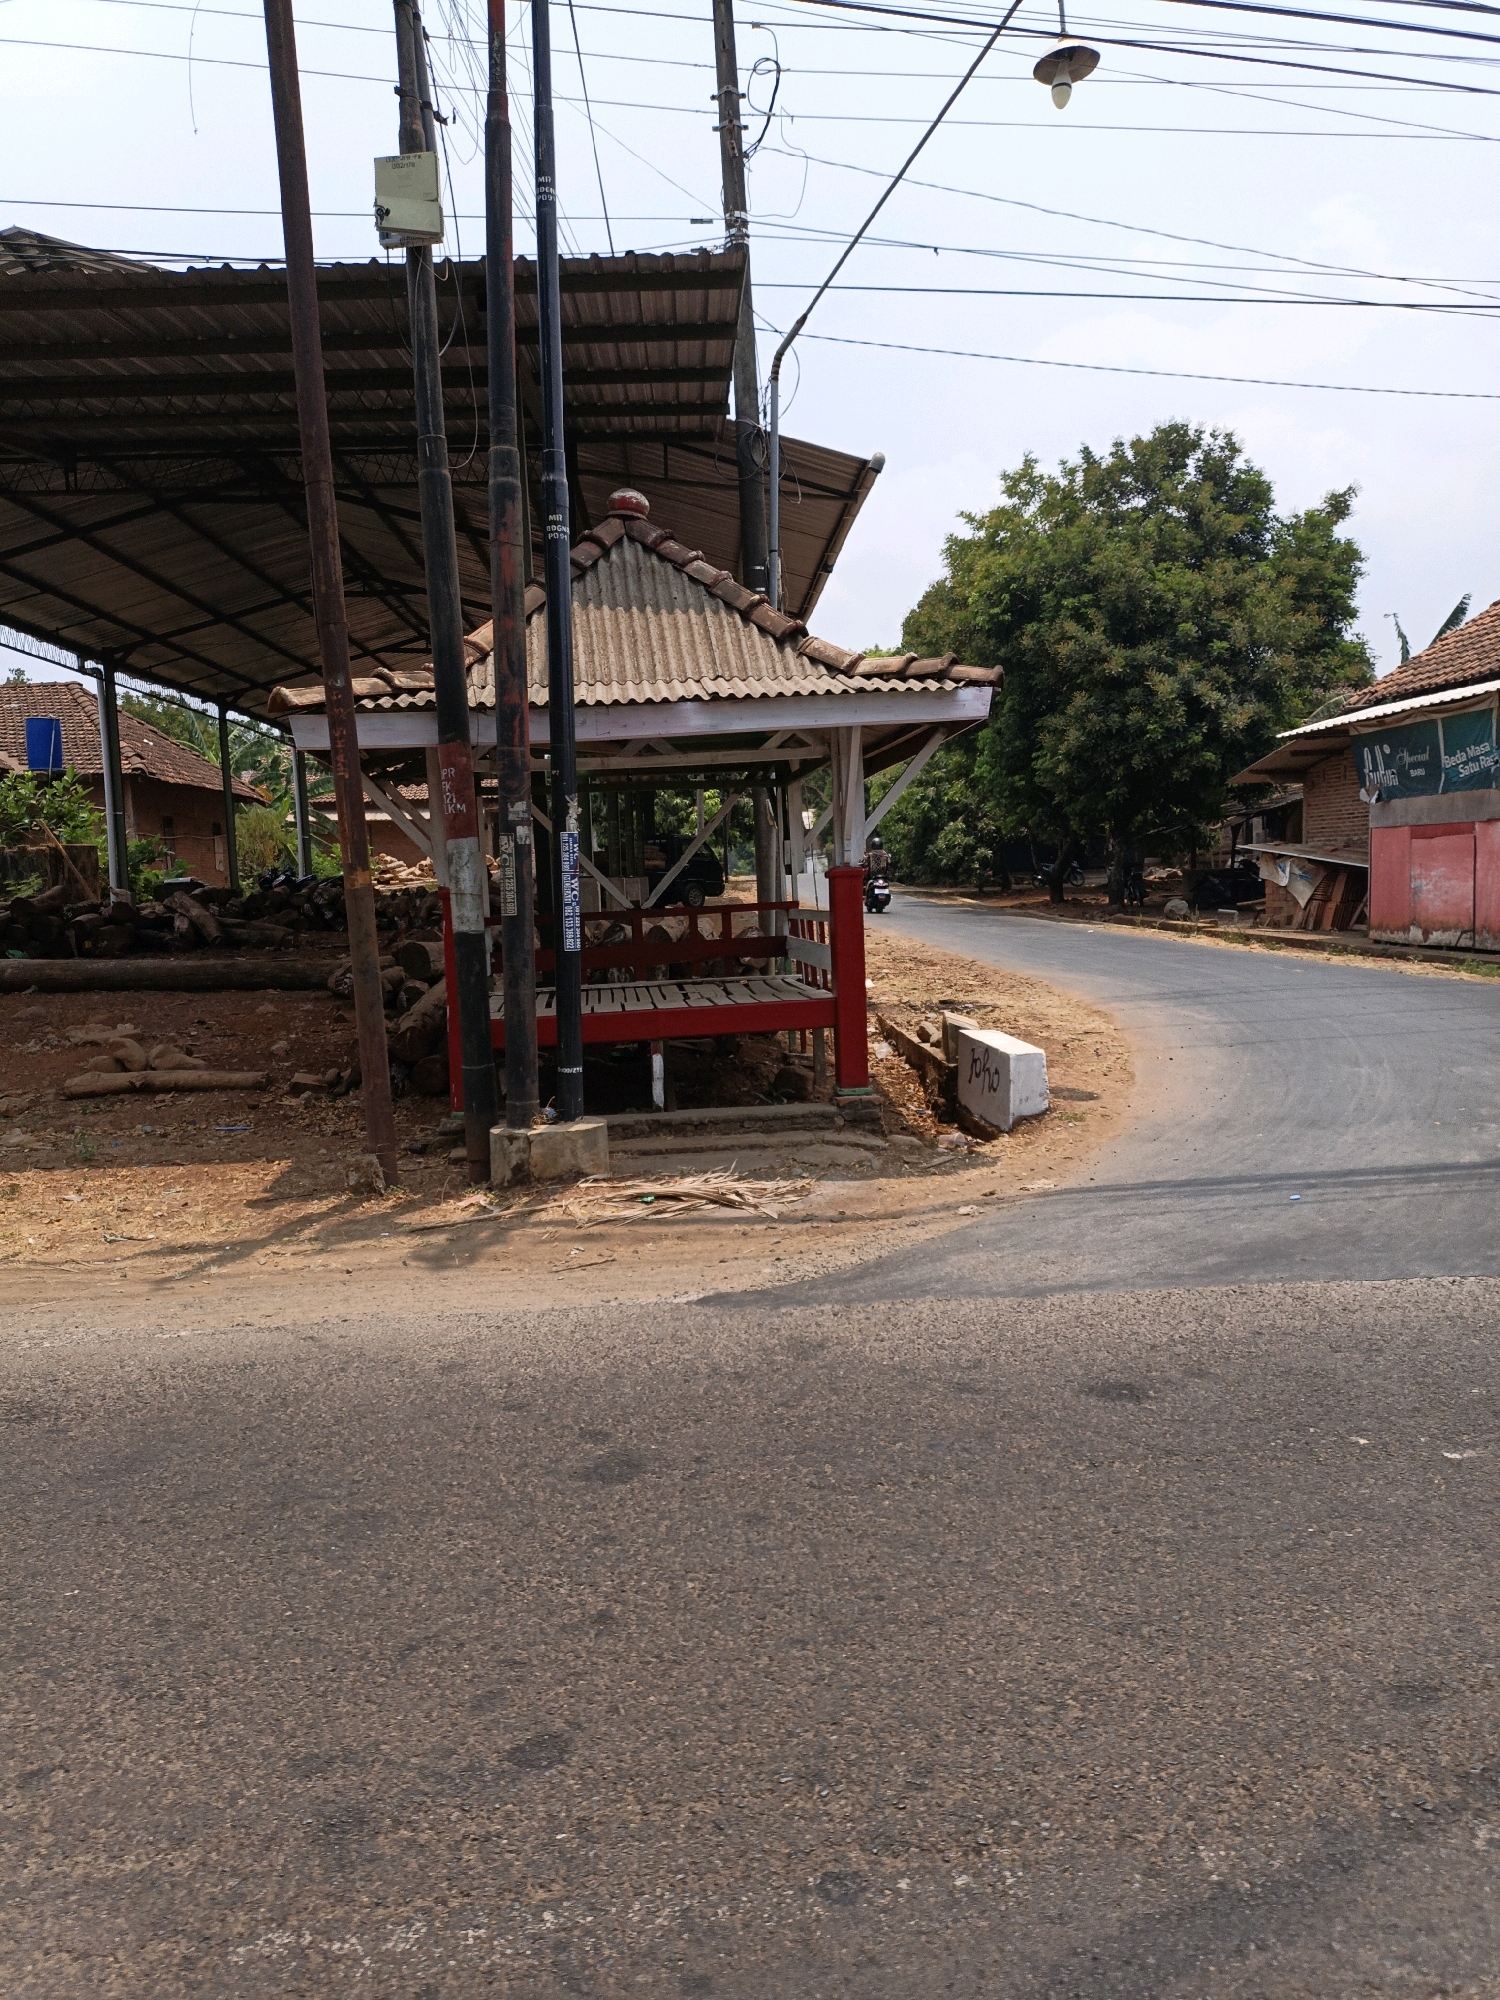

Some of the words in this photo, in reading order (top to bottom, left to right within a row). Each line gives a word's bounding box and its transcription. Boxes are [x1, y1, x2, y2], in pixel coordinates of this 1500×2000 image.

[1443, 750, 1467, 768] Beda
[1466, 742, 1491, 759] Masa
[1458, 761, 1480, 778] Satu
[571, 877, 579, 901] WC
